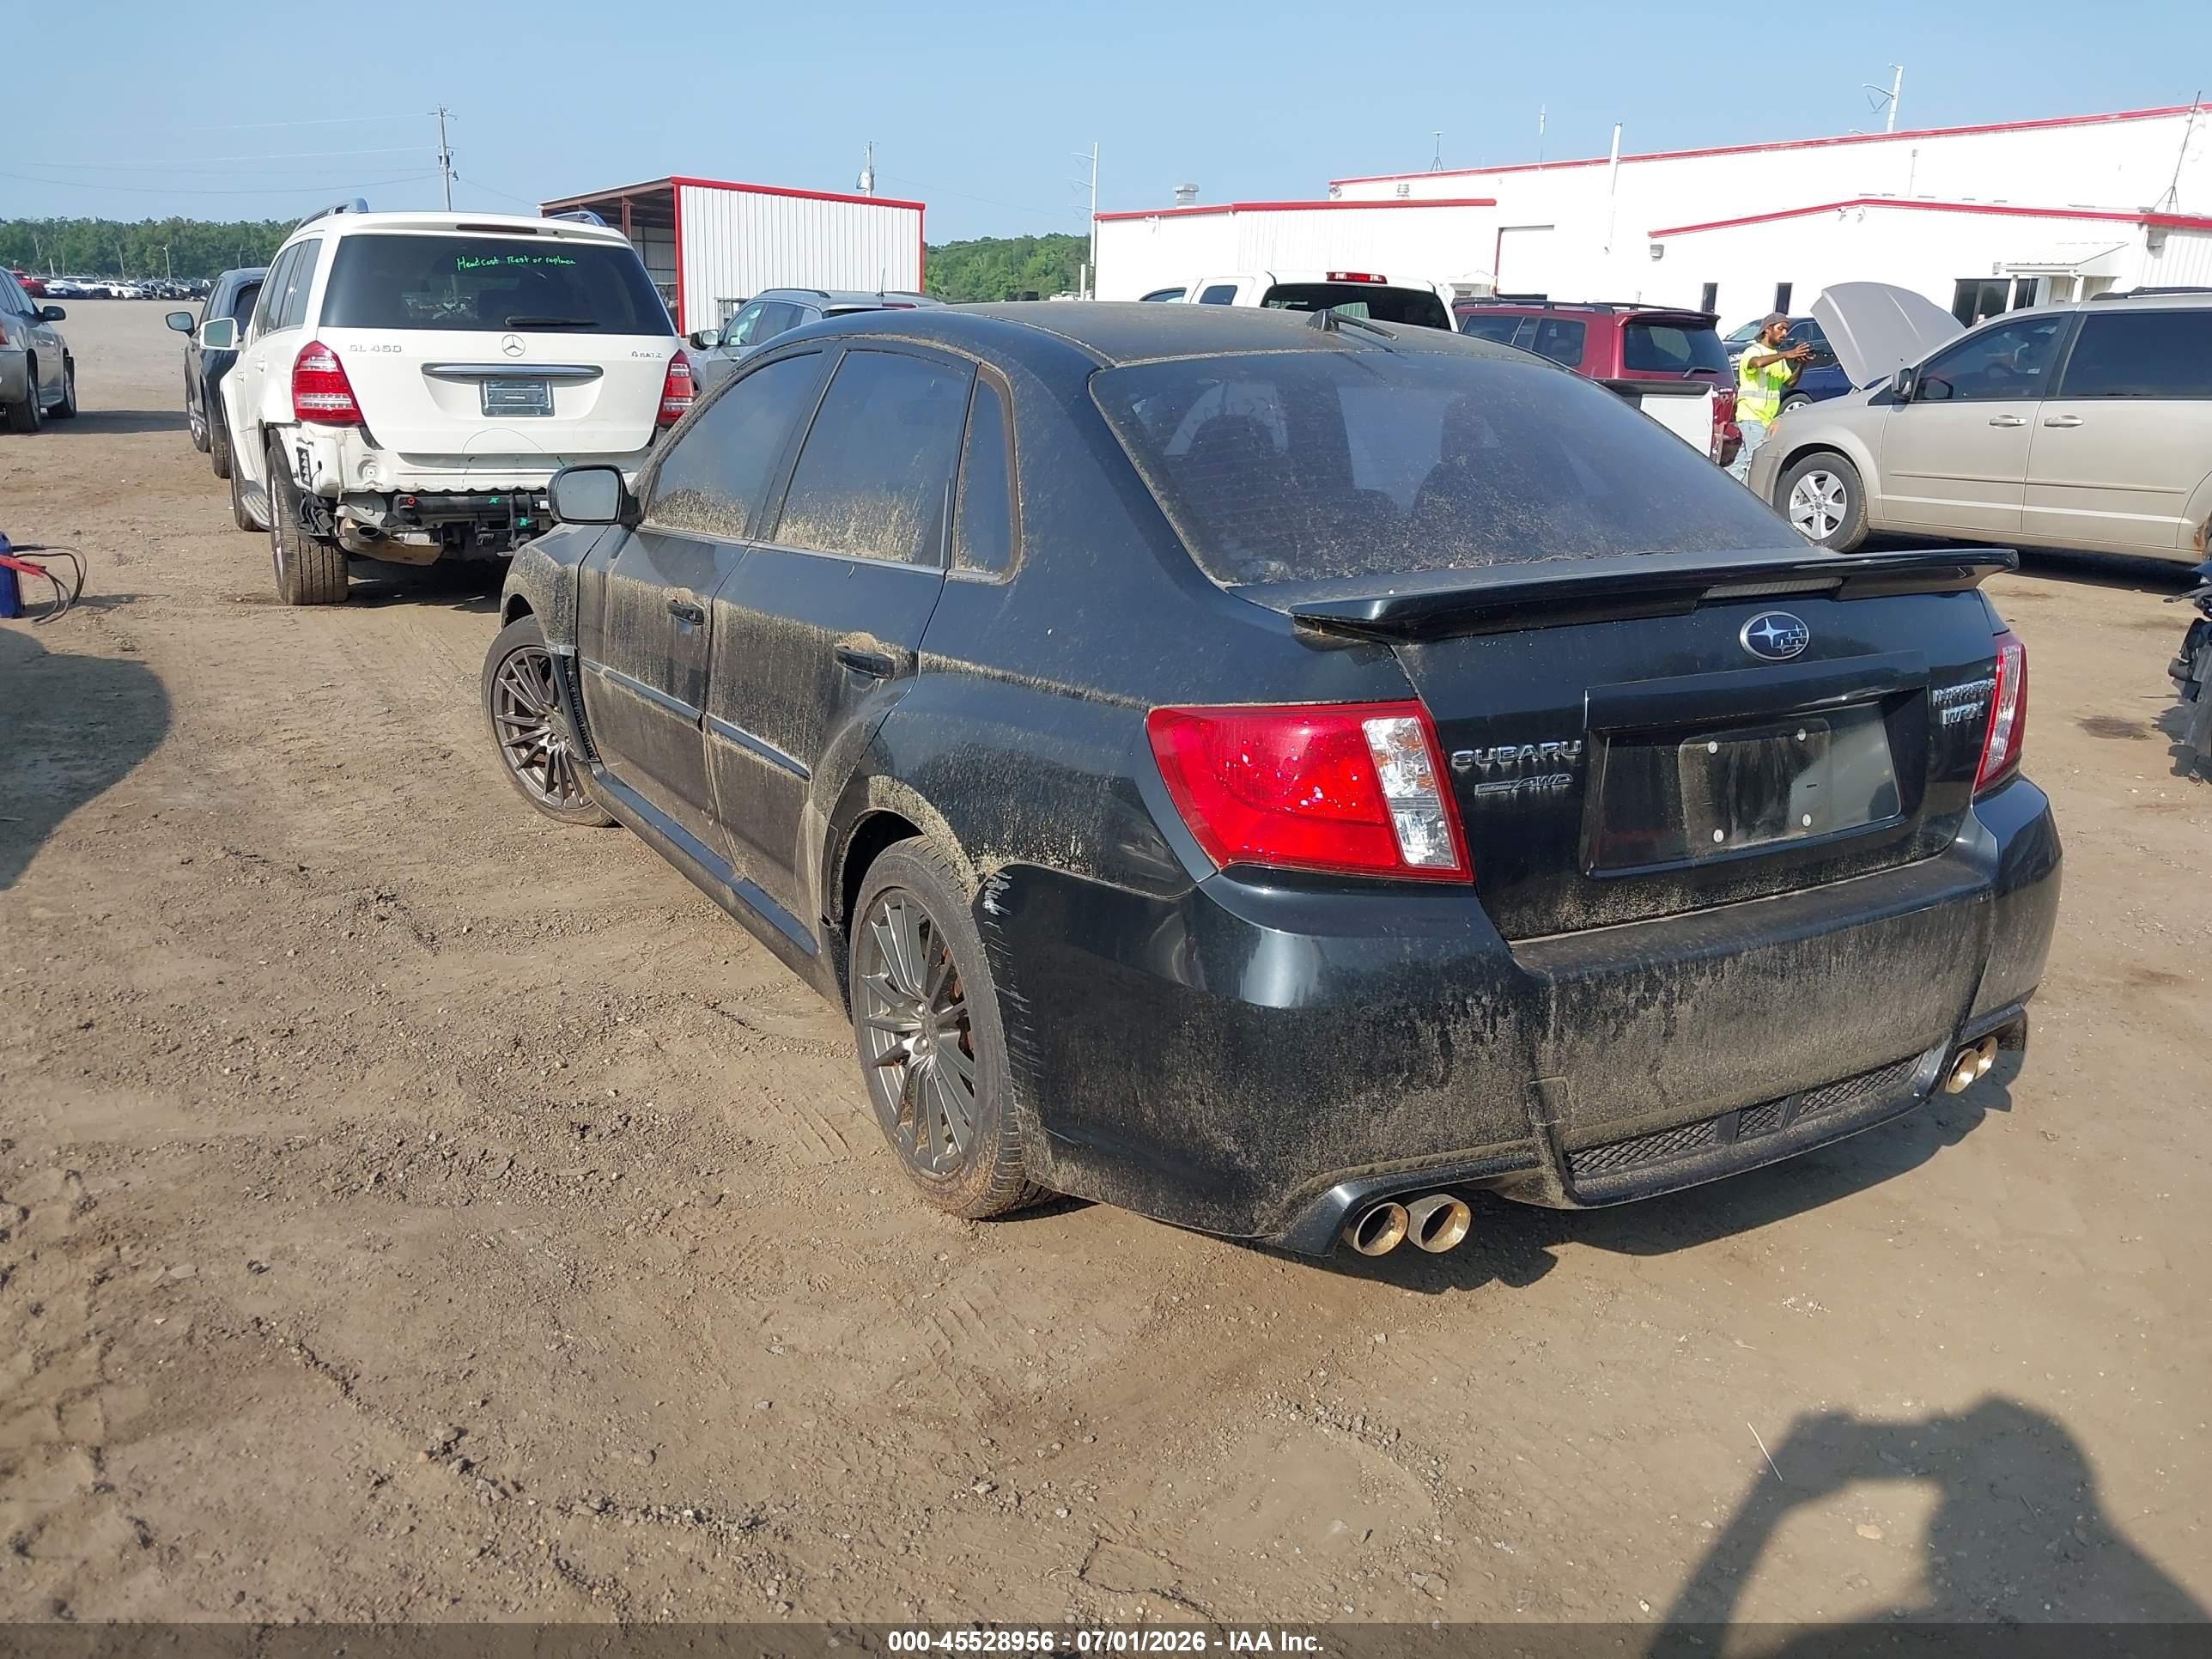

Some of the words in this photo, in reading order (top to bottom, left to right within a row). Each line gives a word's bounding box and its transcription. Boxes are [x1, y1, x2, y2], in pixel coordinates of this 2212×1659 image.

[370, 344, 402, 353] 450
[1942, 700, 1984, 726] WRX
[1451, 739, 1583, 768] SUBARU
[1512, 773, 1574, 793] AWD
